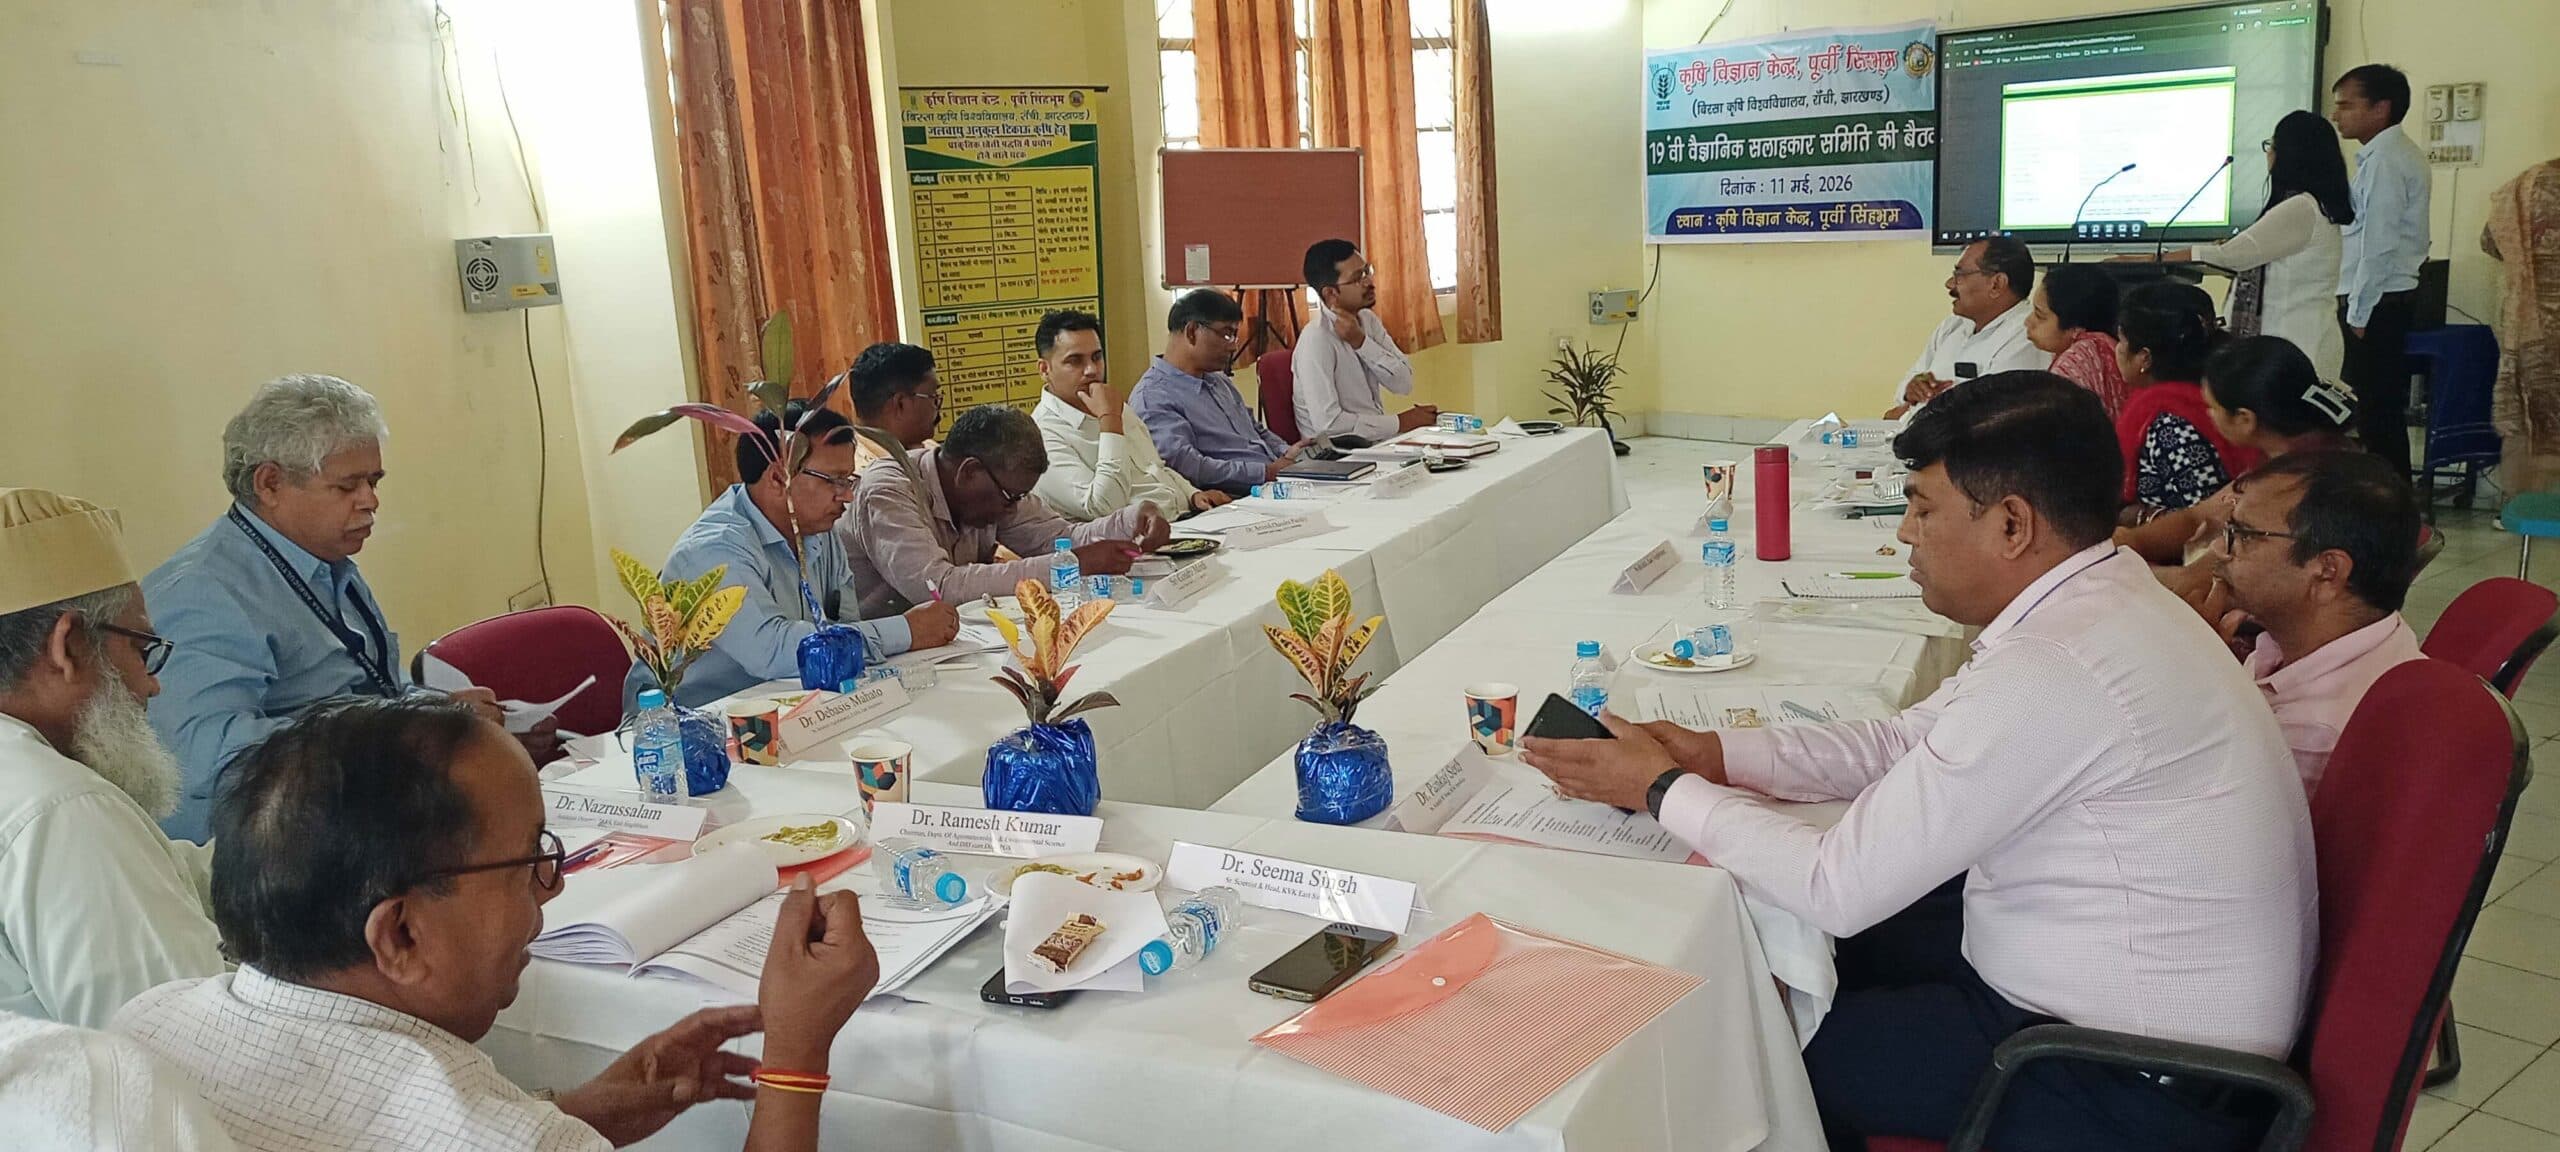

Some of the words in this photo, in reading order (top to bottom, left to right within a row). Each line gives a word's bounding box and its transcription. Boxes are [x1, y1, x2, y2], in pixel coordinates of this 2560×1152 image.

[1679, 61, 1709, 94] कृषि
[1713, 58, 1761, 84] विज्ञान
[1766, 53, 1801, 80] केन्द्र,
[1808, 44, 1842, 81] पूर्वी
[947, 91, 978, 105] विज्ञान
[1726, 97, 1745, 117] कृषि
[1747, 94, 1809, 112] विश्वविद्यालय,
[1649, 142, 1665, 165] 19
[1688, 133, 1746, 162] वैज्ञानिक
[1749, 134, 1816, 159] सलाहकार
[1820, 123, 1872, 154] समिति
[1877, 120, 1899, 149] की
[1721, 176, 1756, 195] दिनांक
[1771, 178, 1784, 194] 11
[1791, 173, 1813, 195] मई,
[1819, 175, 1853, 193] 2026
[1676, 213, 1704, 229] स्थान
[1715, 208, 1739, 232] कृषि
[1742, 207, 1781, 228] विज्ञान
[1785, 207, 1814, 228] केन्द्र,
[1819, 204, 1846, 230] पूर्वी
[1850, 203, 1901, 229] सिंहभूम
[798, 715, 816, 729] Dr.
[815, 702, 851, 721] Debasis
[849, 688, 883, 706] Mahato
[556, 796, 575, 811] Dr.
[579, 797, 662, 821] Nazrussalam
[912, 809, 934, 827] Dr.
[941, 811, 1000, 831] Ramesh
[1005, 815, 1062, 836] Kumar
[1221, 853, 1245, 874] Dr.
[1250, 859, 1304, 884] Seema
[1309, 869, 1357, 896] Singh
